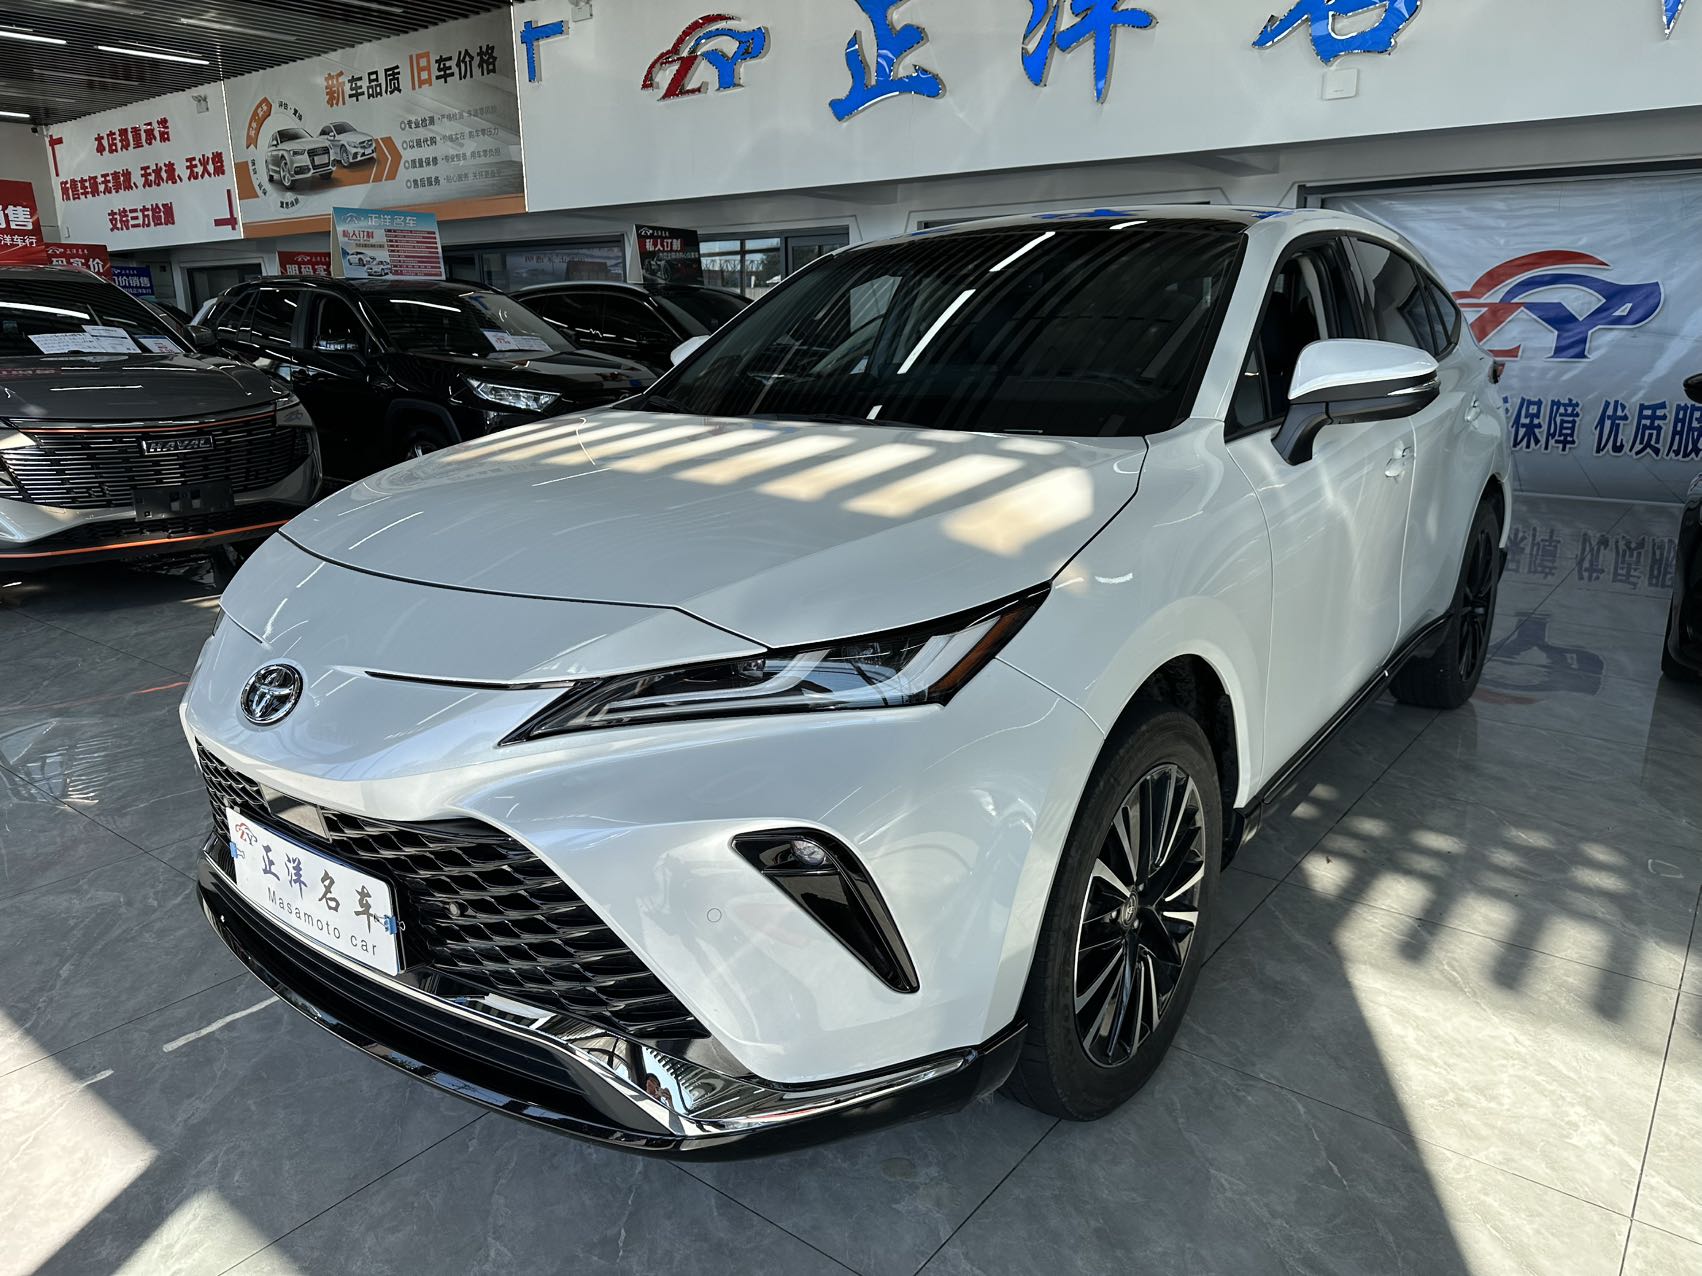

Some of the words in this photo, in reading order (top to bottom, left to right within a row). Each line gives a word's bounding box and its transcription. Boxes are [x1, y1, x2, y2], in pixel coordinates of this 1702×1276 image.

[324, 65, 402, 108] 新车品质
[408, 44, 498, 91] 旧车价格
[407, 115, 435, 129] 专业检测
[94, 117, 171, 157] 本店郑重承诺
[410, 156, 439, 169] 质量保修
[412, 176, 441, 189] 售后服务
[0, 204, 33, 230] 售
[108, 202, 176, 232] 支持三方检测
[367, 214, 417, 227] 正洋名车
[645, 238, 681, 251] 私人订制
[1503, 396, 1584, 452] 保障
[1594, 399, 1702, 460] 优质服
[261, 844, 375, 934] 正洋名车
[267, 887, 341, 940] Masamoto
[350, 934, 377, 956] car
